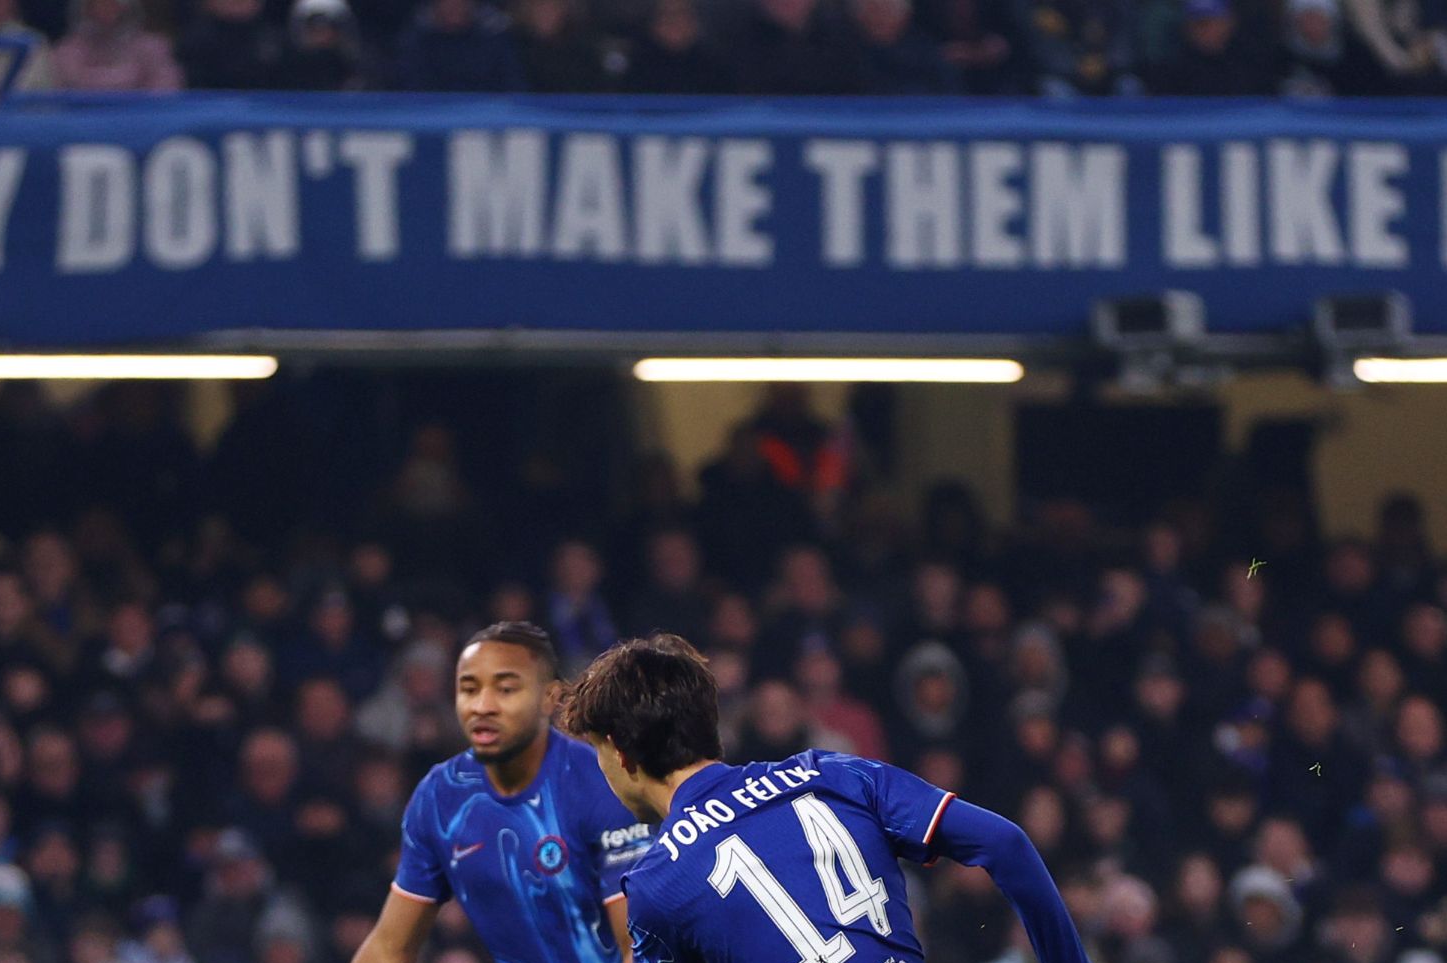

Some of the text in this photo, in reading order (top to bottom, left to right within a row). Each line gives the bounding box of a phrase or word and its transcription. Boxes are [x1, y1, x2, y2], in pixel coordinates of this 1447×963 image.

[55, 130, 413, 273] DON'T
[449, 128, 774, 266] MAKE
[804, 139, 1127, 268] THEM
[1162, 138, 1410, 268] LIKE
[658, 799, 736, 862] JOÃO
